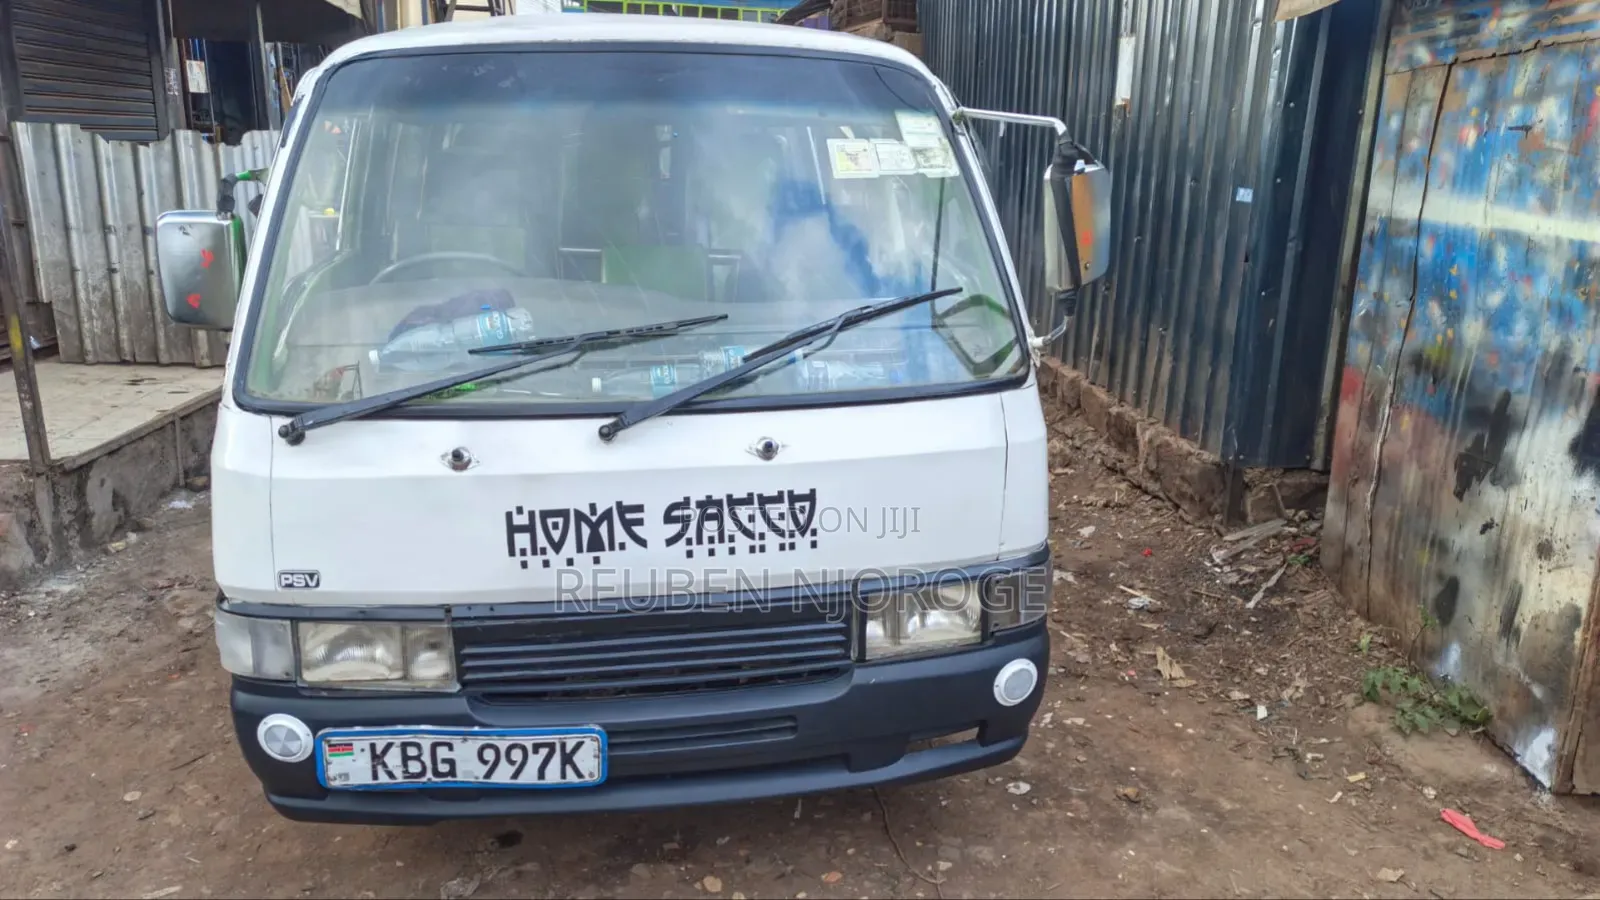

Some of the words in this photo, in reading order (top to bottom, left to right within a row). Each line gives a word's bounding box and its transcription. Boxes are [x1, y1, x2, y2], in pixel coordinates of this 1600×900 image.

[506, 501, 648, 569] HOME
[280, 574, 319, 587] PSV
[369, 741, 457, 781] KBG
[476, 740, 586, 780] 997K
